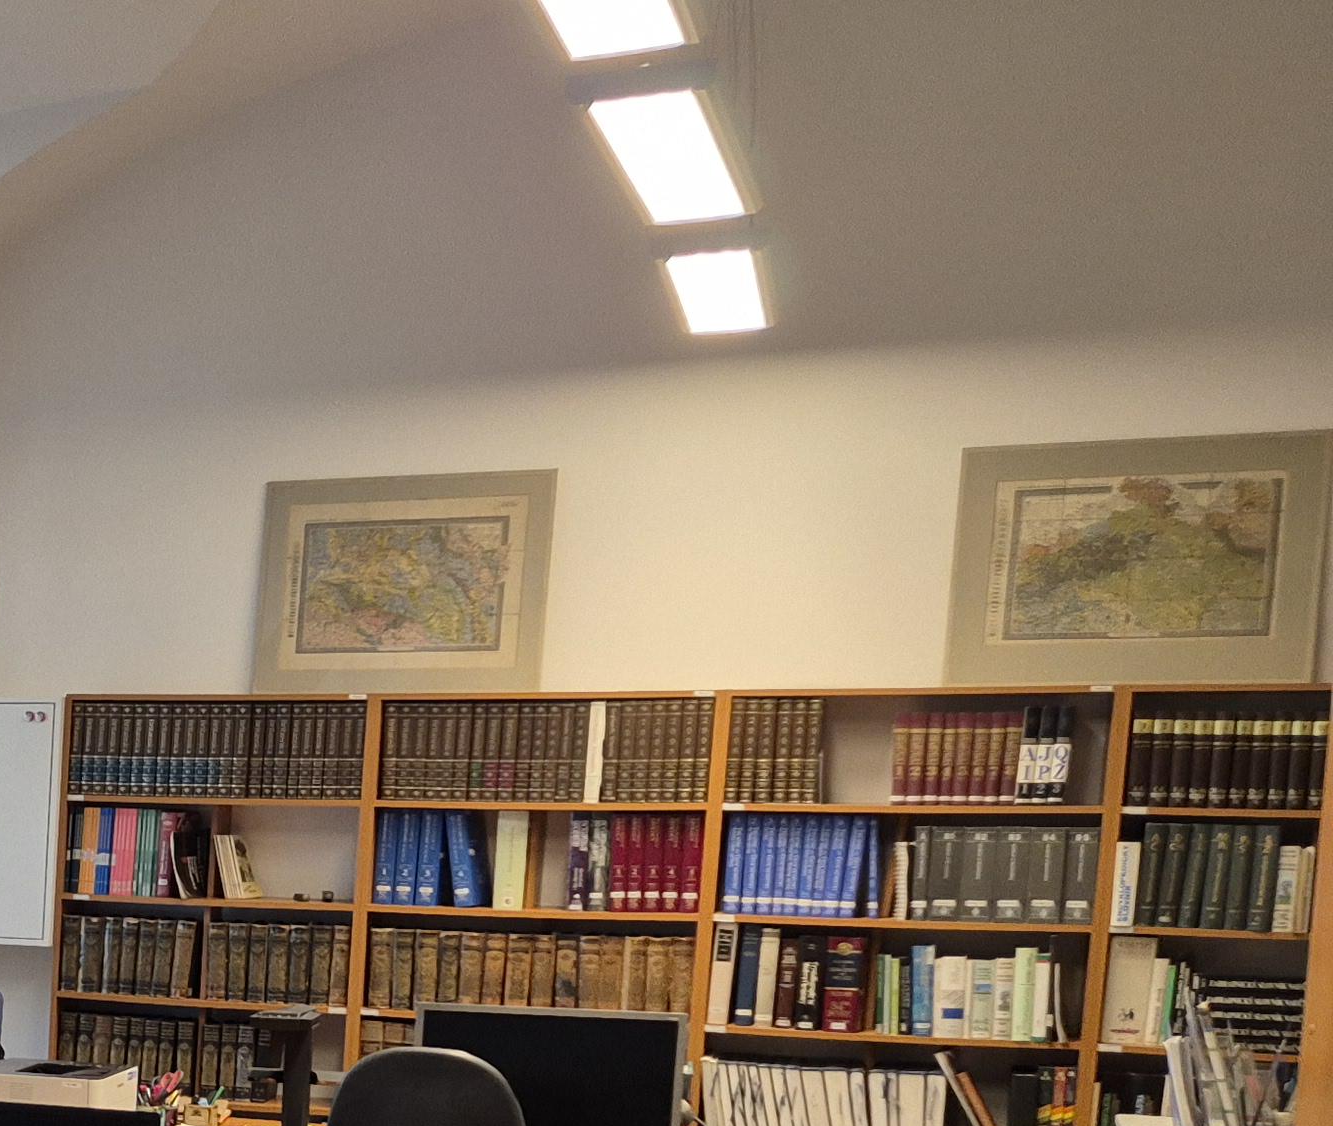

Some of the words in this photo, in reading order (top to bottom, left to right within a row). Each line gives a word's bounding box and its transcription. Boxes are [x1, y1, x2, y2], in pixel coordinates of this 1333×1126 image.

[1022, 747, 1036, 761] A
[1038, 746, 1051, 760] J
[1055, 746, 1068, 763] Q
[1023, 766, 1030, 780] I
[1037, 766, 1051, 779] P
[1053, 765, 1065, 779] Z
[1022, 783, 1029, 794] 1
[1036, 783, 1046, 794] 2
[1052, 783, 1061, 793] 3
